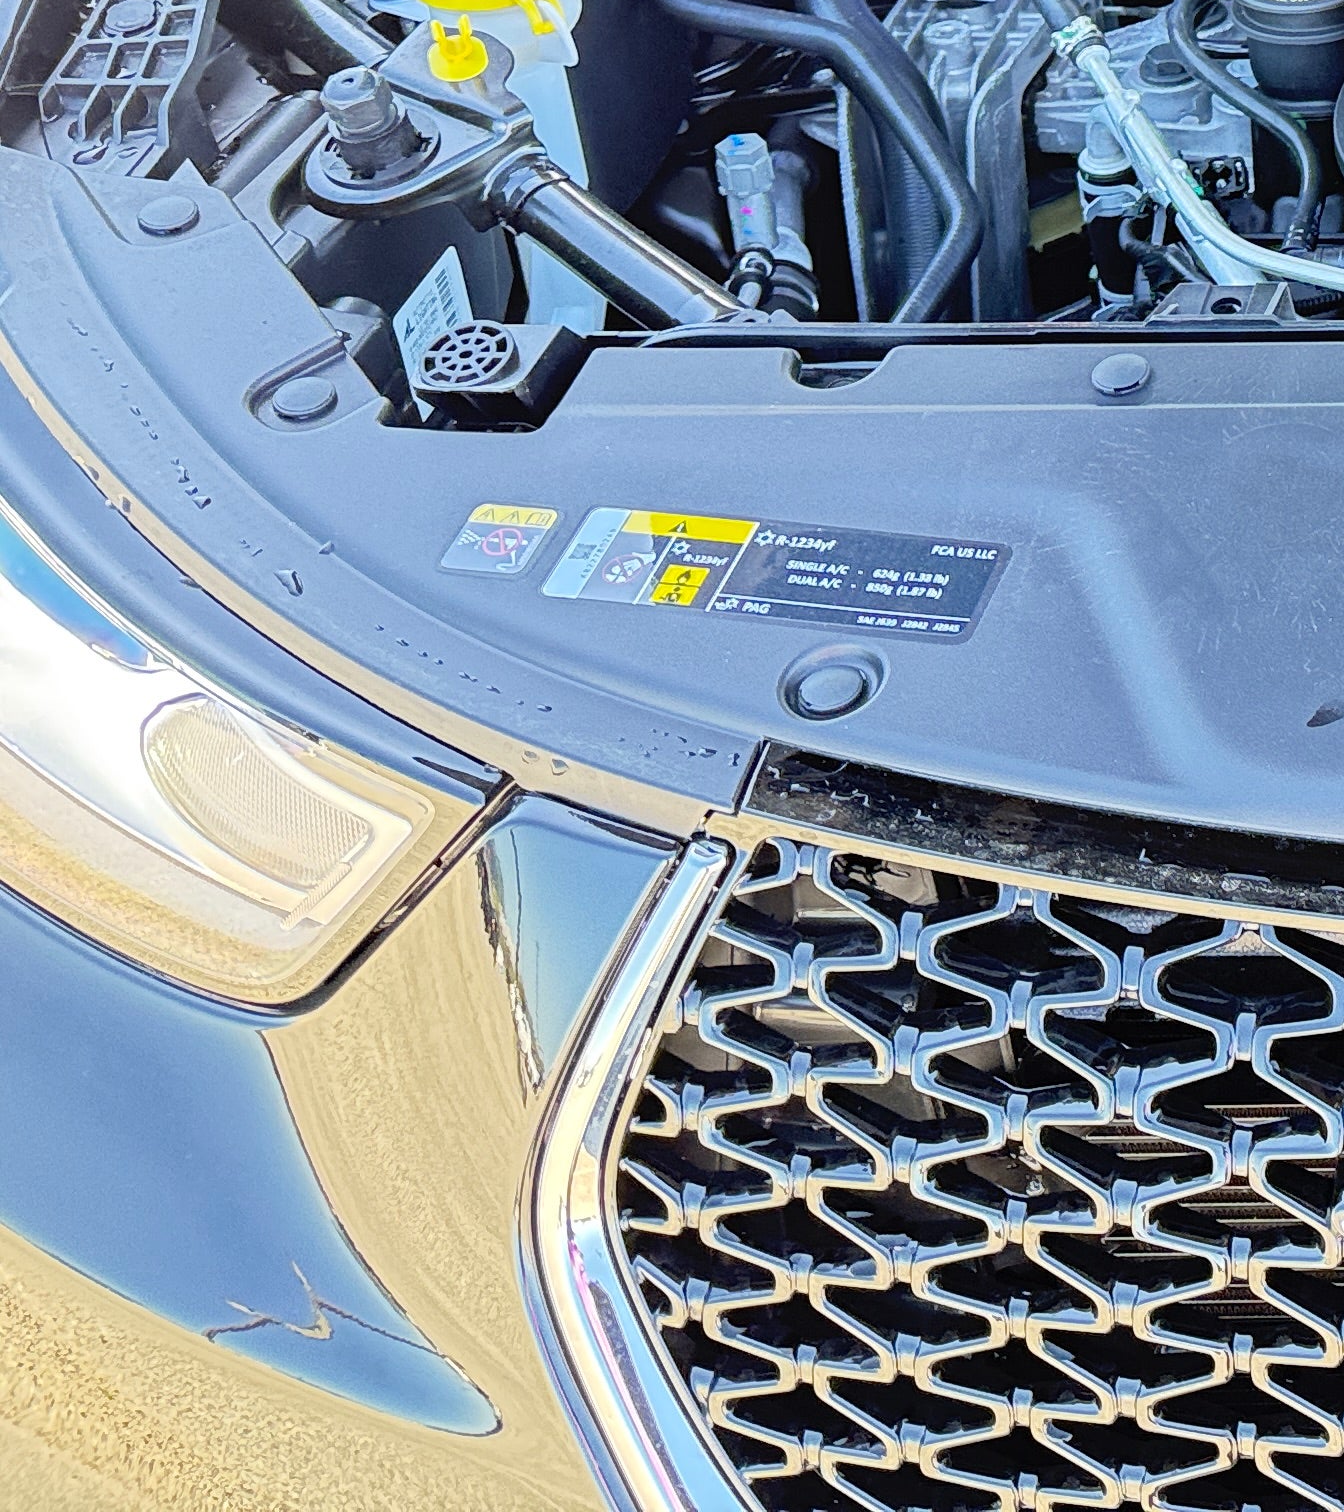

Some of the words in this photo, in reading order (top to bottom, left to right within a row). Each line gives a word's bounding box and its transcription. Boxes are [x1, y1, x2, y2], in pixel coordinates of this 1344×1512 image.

[774, 535, 836, 551] R-1234yf
[931, 545, 955, 557] FCA
[956, 547, 975, 558] US
[976, 549, 998, 560] LLC
[786, 559, 827, 573] SINGLE
[826, 563, 850, 575] A/C
[872, 568, 900, 582] 624g
[933, 574, 950, 586] lb)
[787, 574, 818, 587] DUAL
[818, 577, 842, 589] A/C
[925, 587, 943, 600] lb)
[742, 601, 771, 614] PAG
[857, 615, 876, 625] SAE
